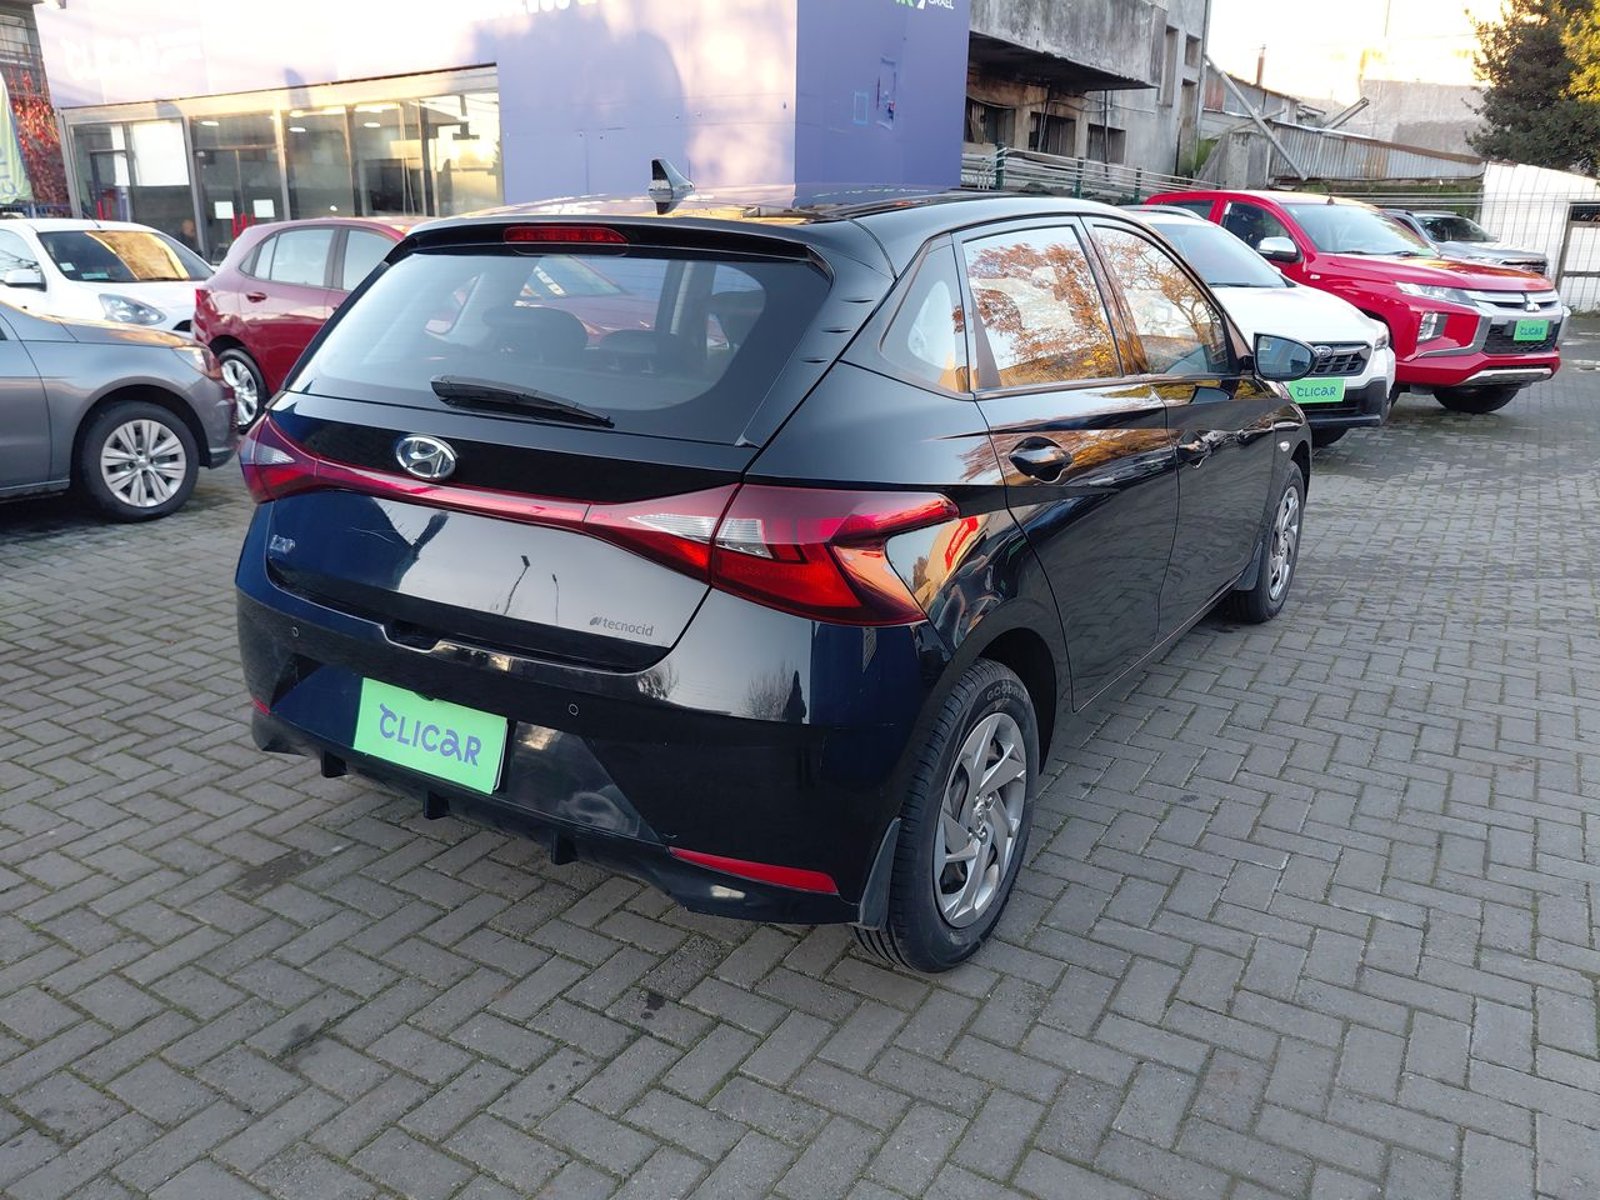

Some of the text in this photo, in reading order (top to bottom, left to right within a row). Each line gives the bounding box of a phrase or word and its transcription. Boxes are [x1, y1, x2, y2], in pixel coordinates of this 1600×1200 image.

[1296, 386, 1337, 397] CLICAR
[603, 618, 655, 637] tecnocid
[379, 703, 482, 767] CLICAR
